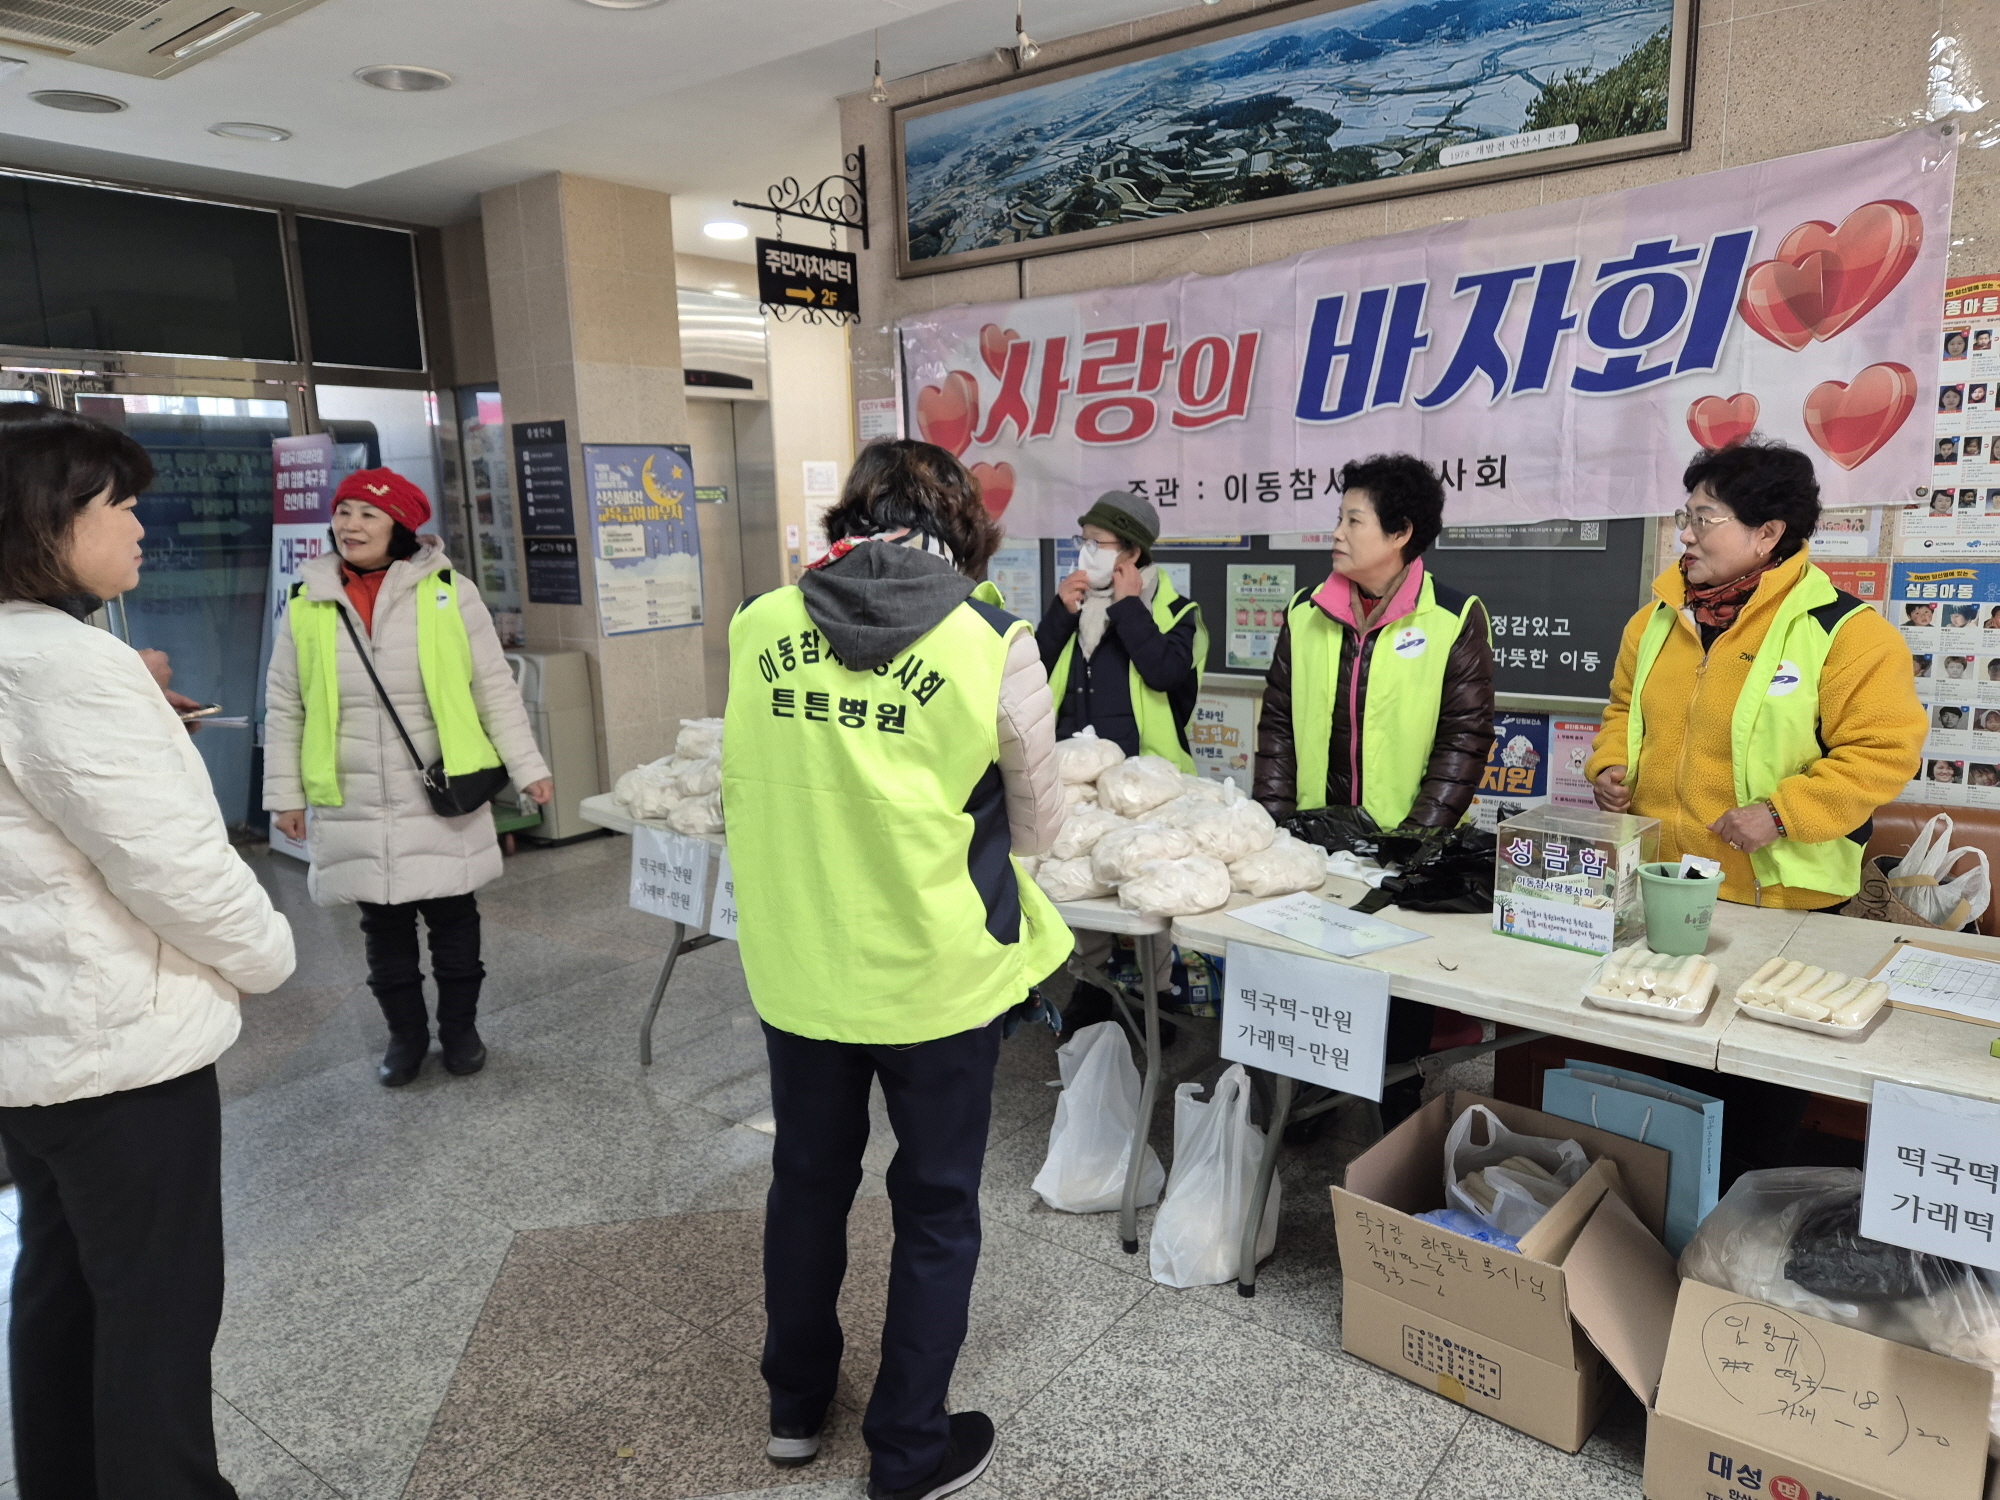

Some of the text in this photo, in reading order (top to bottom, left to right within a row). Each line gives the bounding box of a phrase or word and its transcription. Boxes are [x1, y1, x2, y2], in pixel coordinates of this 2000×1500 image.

[1450, 150, 1470, 161] 1978
[1475, 142, 1505, 156] 개발전
[1509, 134, 1541, 150] 안산시
[764, 248, 852, 285] 주민자치센터
[821, 288, 838, 306] 2F
[974, 226, 1758, 447] 사랑의 바자회
[1127, 478, 1180, 507] 주관
[598, 504, 683, 522] 교육급여 바우처
[1905, 583, 1974, 599] 실종아동
[1491, 614, 1571, 638] 정감있고
[1492, 647, 1601, 672] 따뜻한 이동
[771, 687, 906, 735] 튼튼병원
[1196, 708, 1224, 723] 온라인
[1195, 746, 1224, 759] 이벤트
[1478, 765, 1536, 795] 지원
[640, 857, 693, 885] 떡국떡-만원
[1506, 837, 1608, 878] 성금함
[1516, 874, 1594, 898] 이동참사랑봉사회
[1240, 988, 1353, 1034] 떡국떡-만원
[1237, 1024, 1350, 1072] 가래떡-만원
[1897, 1145, 1999, 1195] 떡국떡
[1890, 1193, 1994, 1243] 가래떡
[1453, 1342, 1474, 1358] 전문점
[1707, 1451, 1763, 1491] 대성
